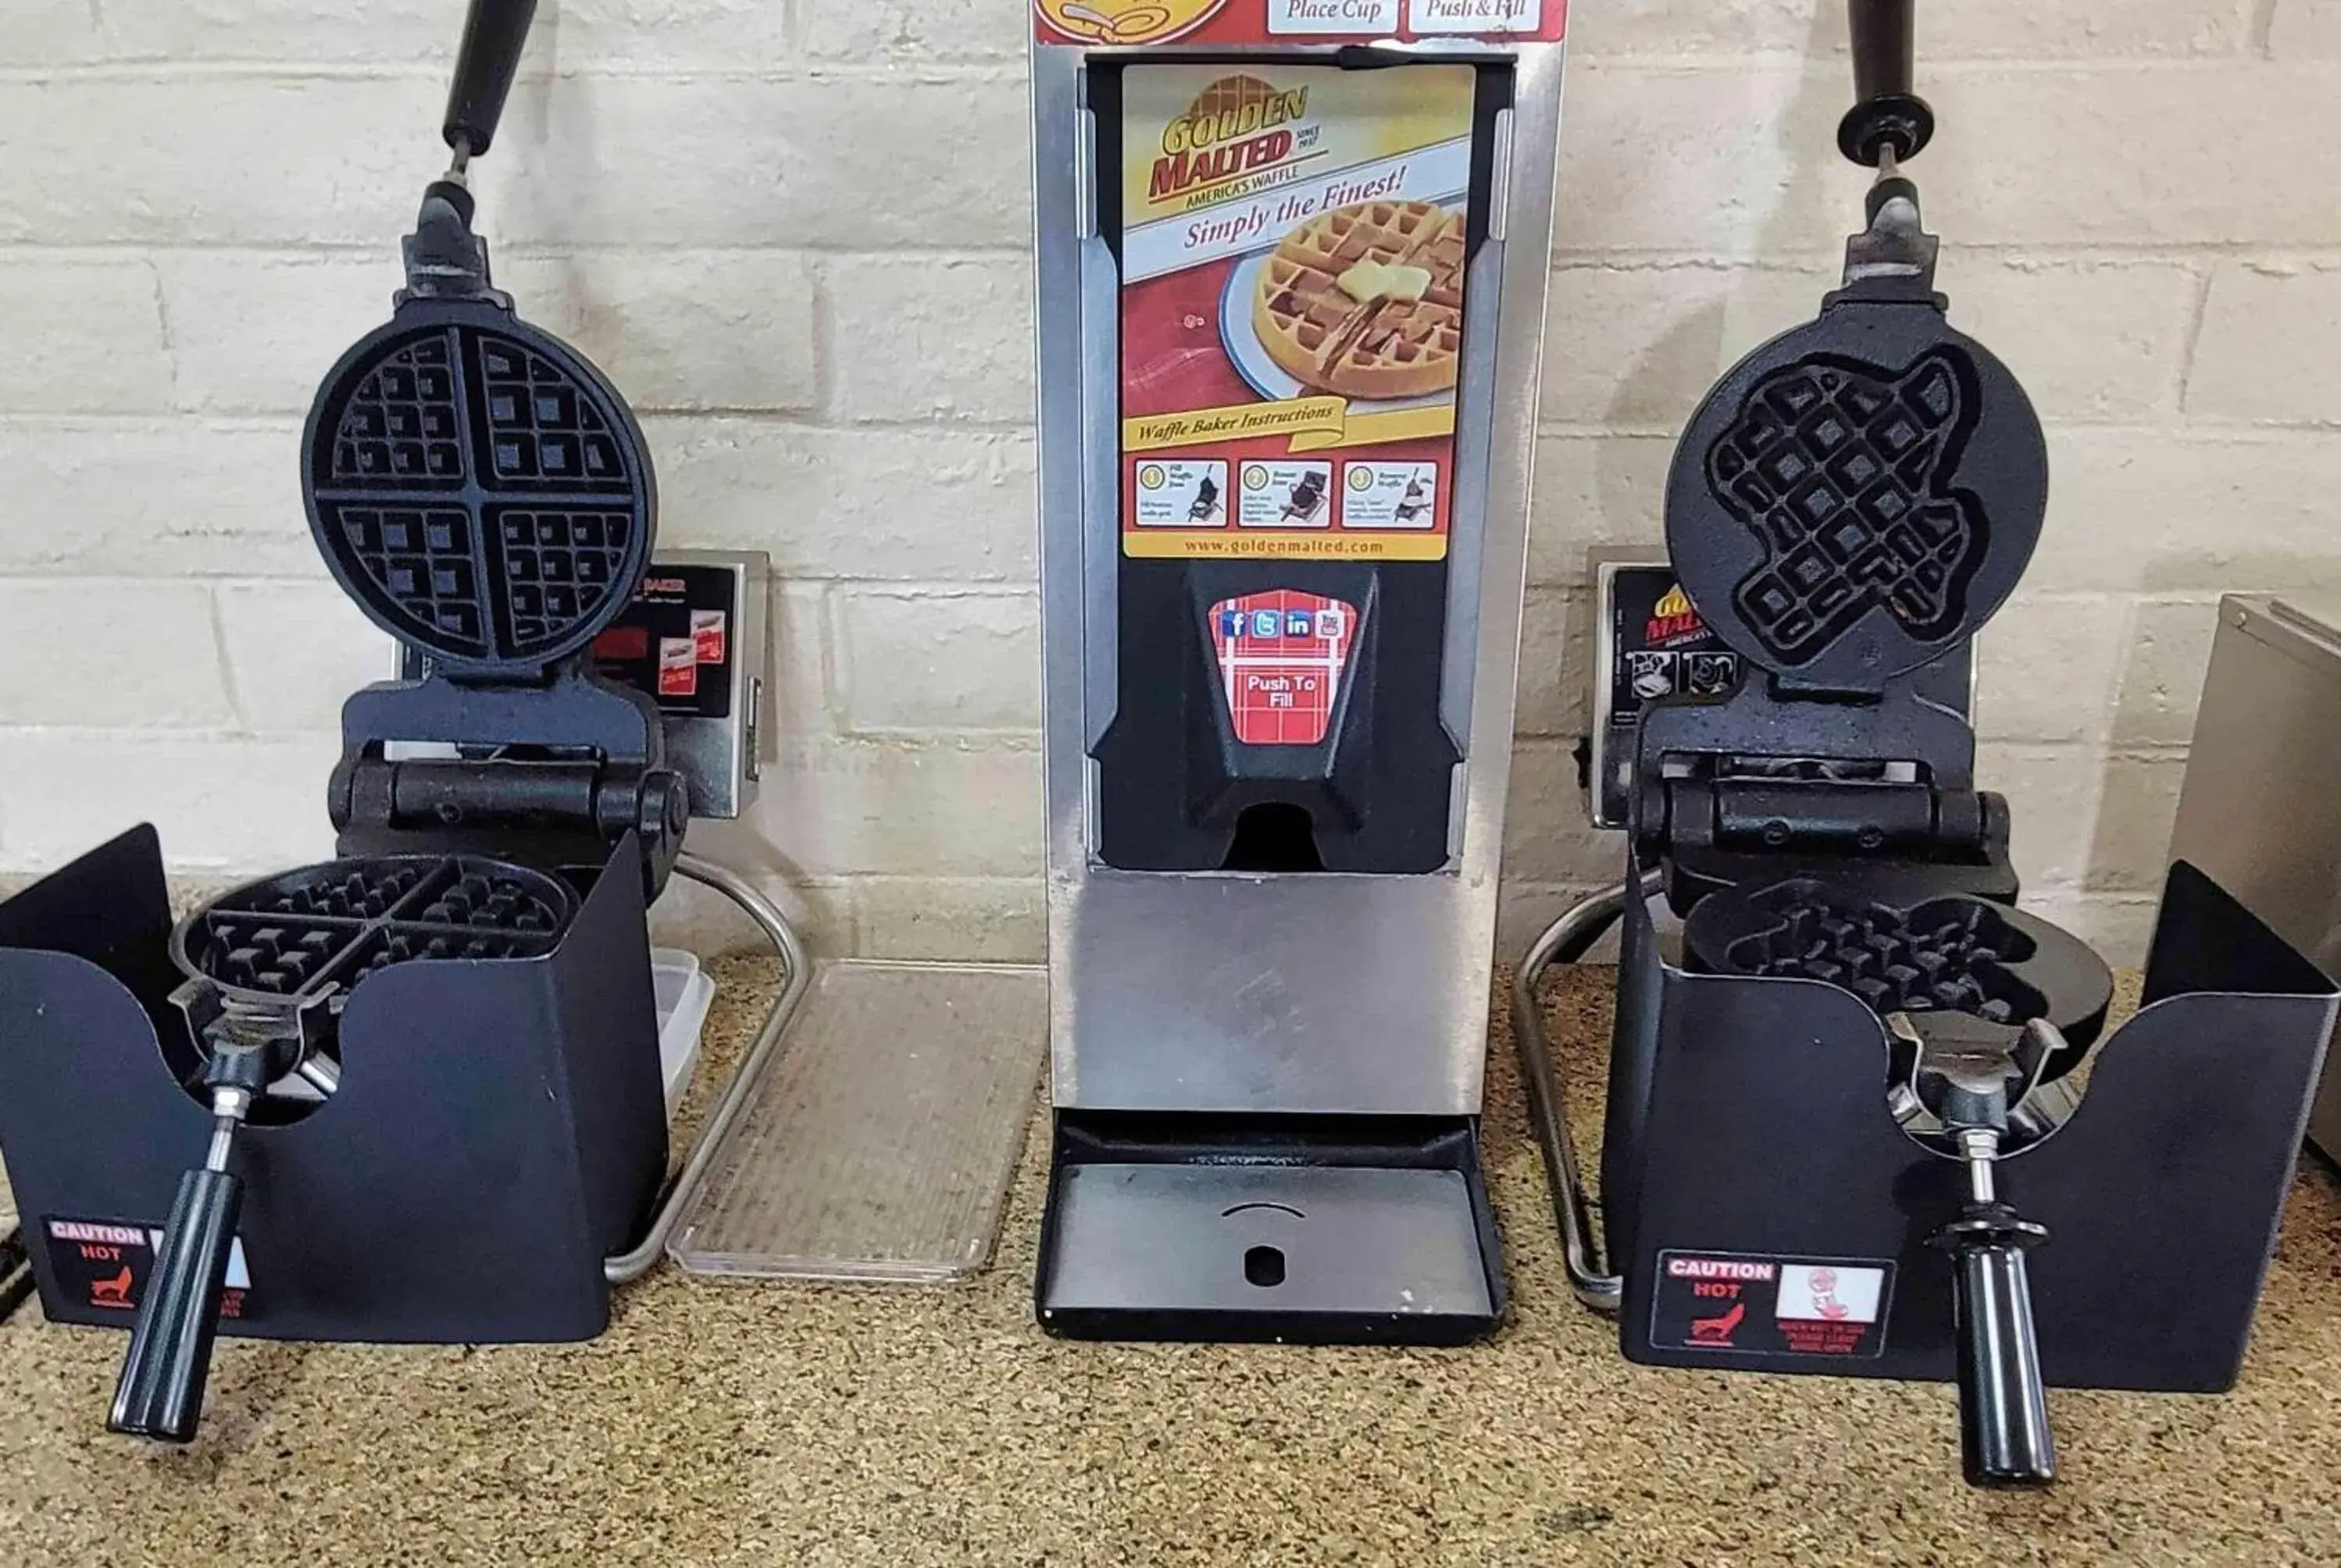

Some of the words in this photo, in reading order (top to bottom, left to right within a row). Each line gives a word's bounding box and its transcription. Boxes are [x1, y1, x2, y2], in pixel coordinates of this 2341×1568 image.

[1287, 0, 1336, 19] Place
[1341, 0, 1381, 23] Cup
[1427, 0, 1471, 17] Push
[1476, 0, 1491, 16] &
[1162, 84, 1308, 156] GOLDEN
[1148, 130, 1293, 197] MALTED
[1186, 179, 1251, 208] AMERICA'S
[1252, 165, 1299, 190] WAFFLE
[1184, 203, 1269, 248] Simply
[1276, 195, 1314, 223] the
[1321, 165, 1408, 211] Finest!
[1139, 420, 1190, 440] Waffle
[1192, 415, 1239, 433] Baker
[1240, 405, 1334, 428] Instructions
[1185, 540, 1383, 555] www.goldenmalted.com
[1287, 614, 1309, 634] in
[1247, 675, 1290, 691] Push
[1294, 676, 1315, 690] To
[1269, 693, 1294, 708] Fill
[50, 1221, 146, 1245] CAUTION
[80, 1245, 122, 1262] HOT
[1668, 1259, 1773, 1280] CAUTION
[1692, 1282, 1742, 1299] HOT
